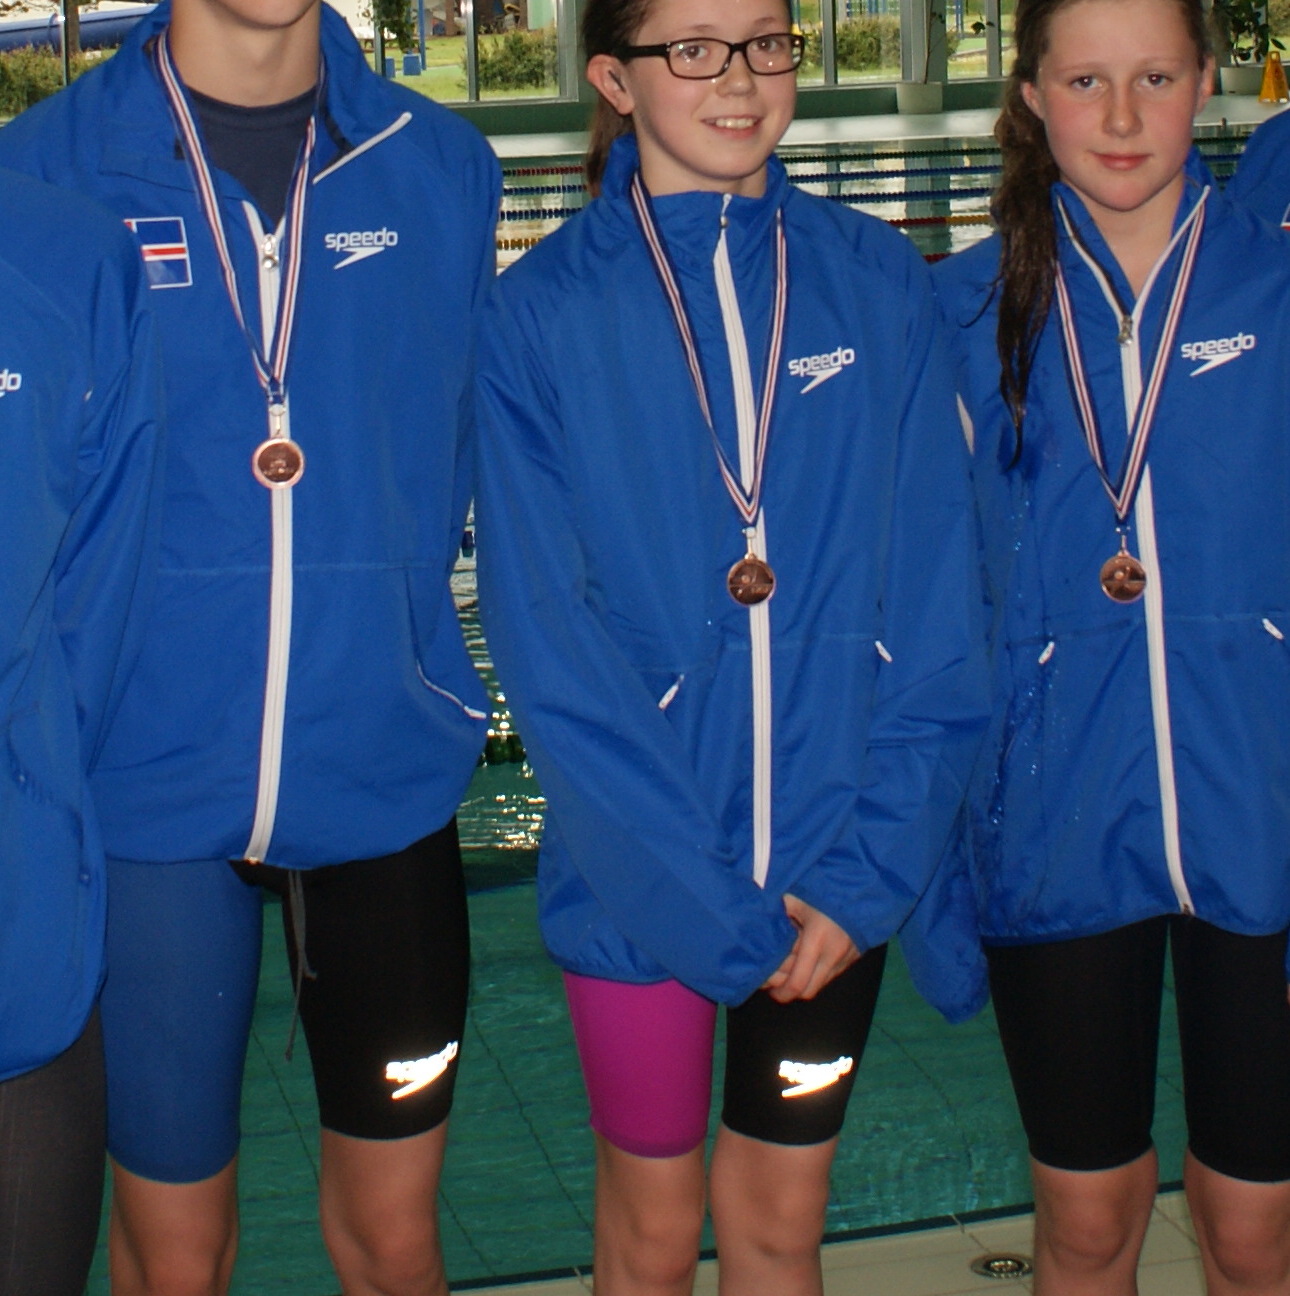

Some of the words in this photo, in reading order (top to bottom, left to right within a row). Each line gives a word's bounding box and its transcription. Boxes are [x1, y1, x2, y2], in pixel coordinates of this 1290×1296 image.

[323, 226, 399, 252] speedo
[1181, 332, 1256, 361] speedo
[788, 346, 855, 377] speedo
